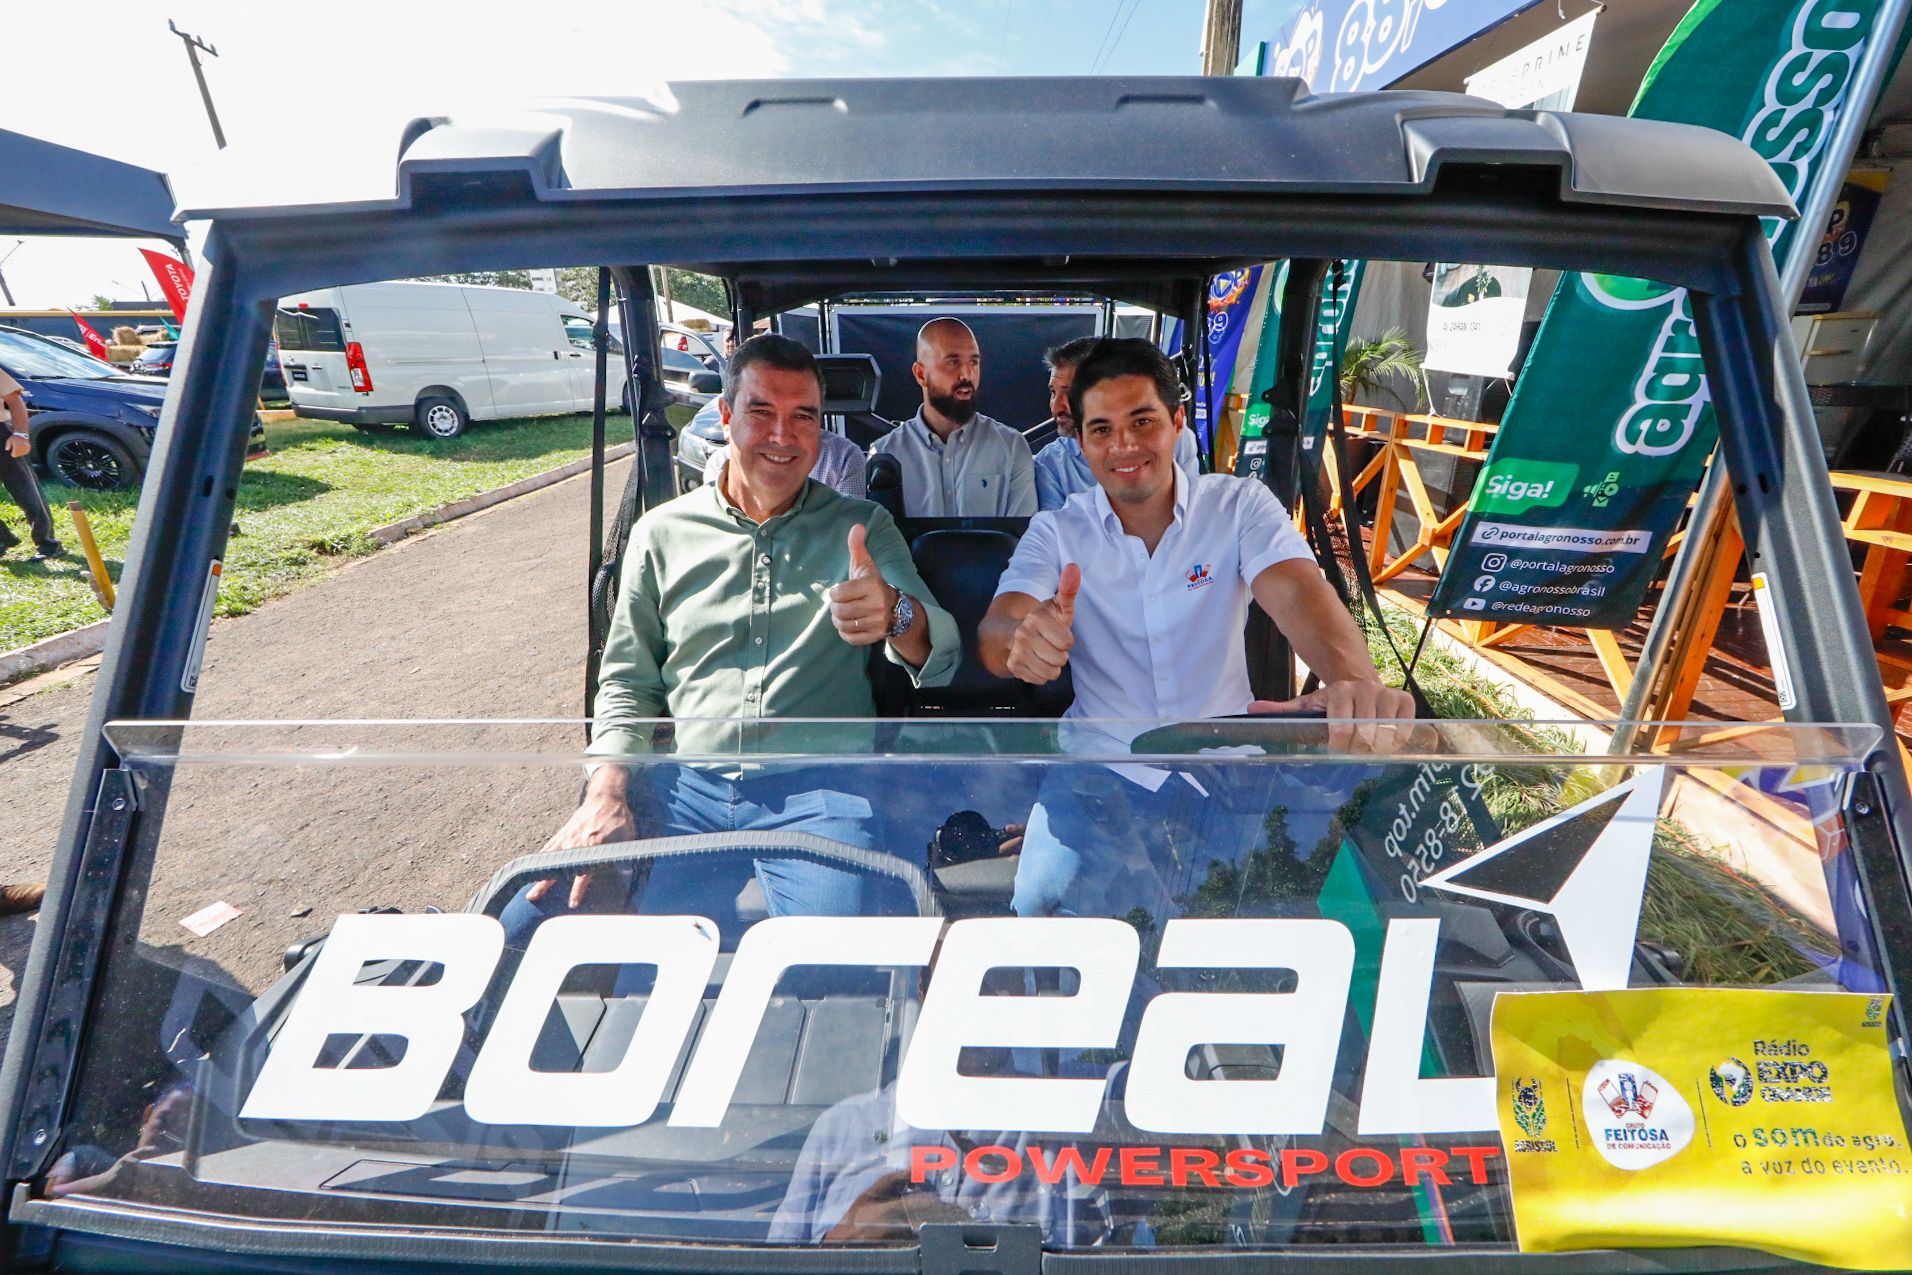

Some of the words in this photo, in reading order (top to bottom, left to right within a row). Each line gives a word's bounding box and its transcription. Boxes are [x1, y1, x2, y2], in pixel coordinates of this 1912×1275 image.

[165, 263, 189, 301] TOYOTA
[1485, 474, 1554, 500] Siga!
[1500, 528, 1640, 546] portalagronosso.com.br
[1510, 559, 1615, 575] @portalagronosso
[1499, 580, 1606, 597] @agronossobrasil
[1491, 601, 1591, 617] @redeagronosso
[1754, 1039, 1810, 1057] Rádio
[1757, 1060, 1828, 1083] EXPO
[1605, 1128, 1669, 1142] FEITOSA
[1734, 1133, 1747, 1148] o
[1752, 1127, 1820, 1148] som
[1823, 1132, 1846, 1147] do
[1618, 1142, 1672, 1152] COMUNICAÇÃO
[910, 1145, 1502, 1188] POWERSPORT
[1741, 1160, 1753, 1174] a
[1759, 1160, 1796, 1175] voz
[1801, 1157, 1826, 1174] do
[1832, 1157, 1909, 1174] evento.
